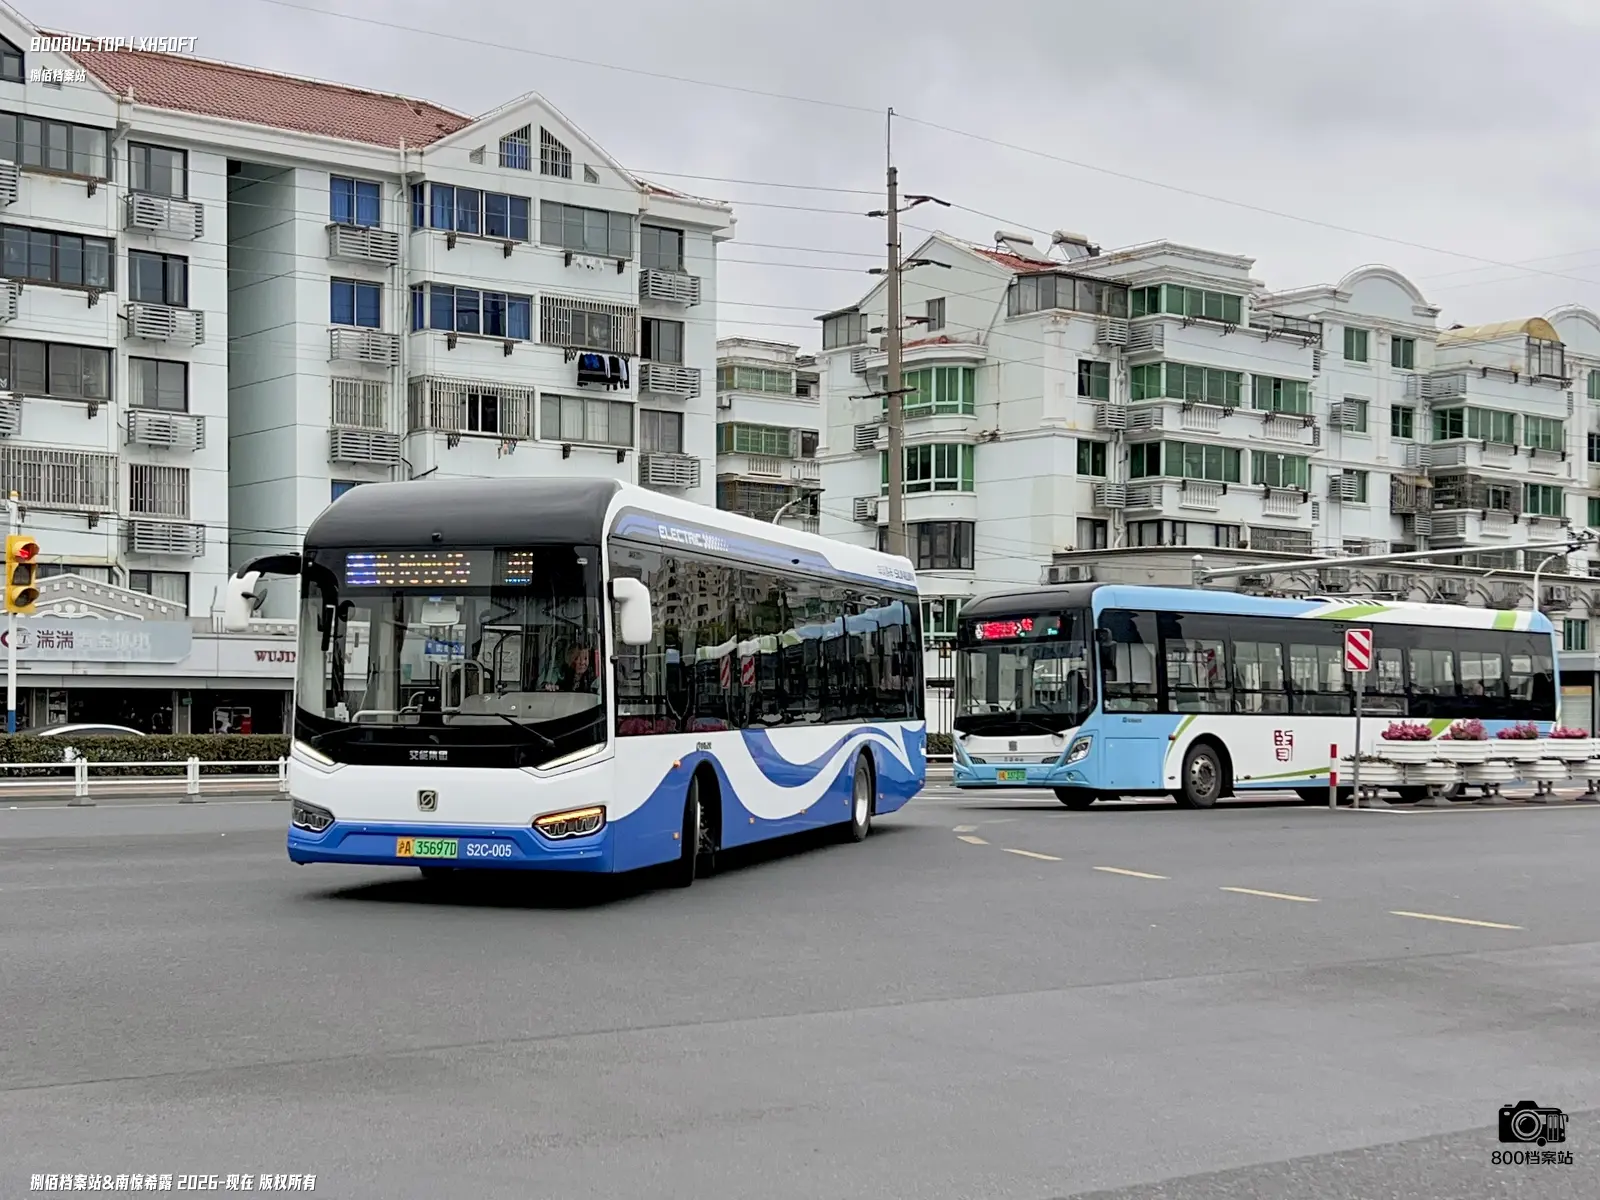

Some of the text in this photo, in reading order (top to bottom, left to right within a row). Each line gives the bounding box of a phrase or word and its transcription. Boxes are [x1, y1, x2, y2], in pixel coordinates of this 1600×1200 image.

[658, 524, 704, 548] ELECTRIC
[415, 840, 457, 856] 35697D
[466, 843, 512, 858] S2C-005
